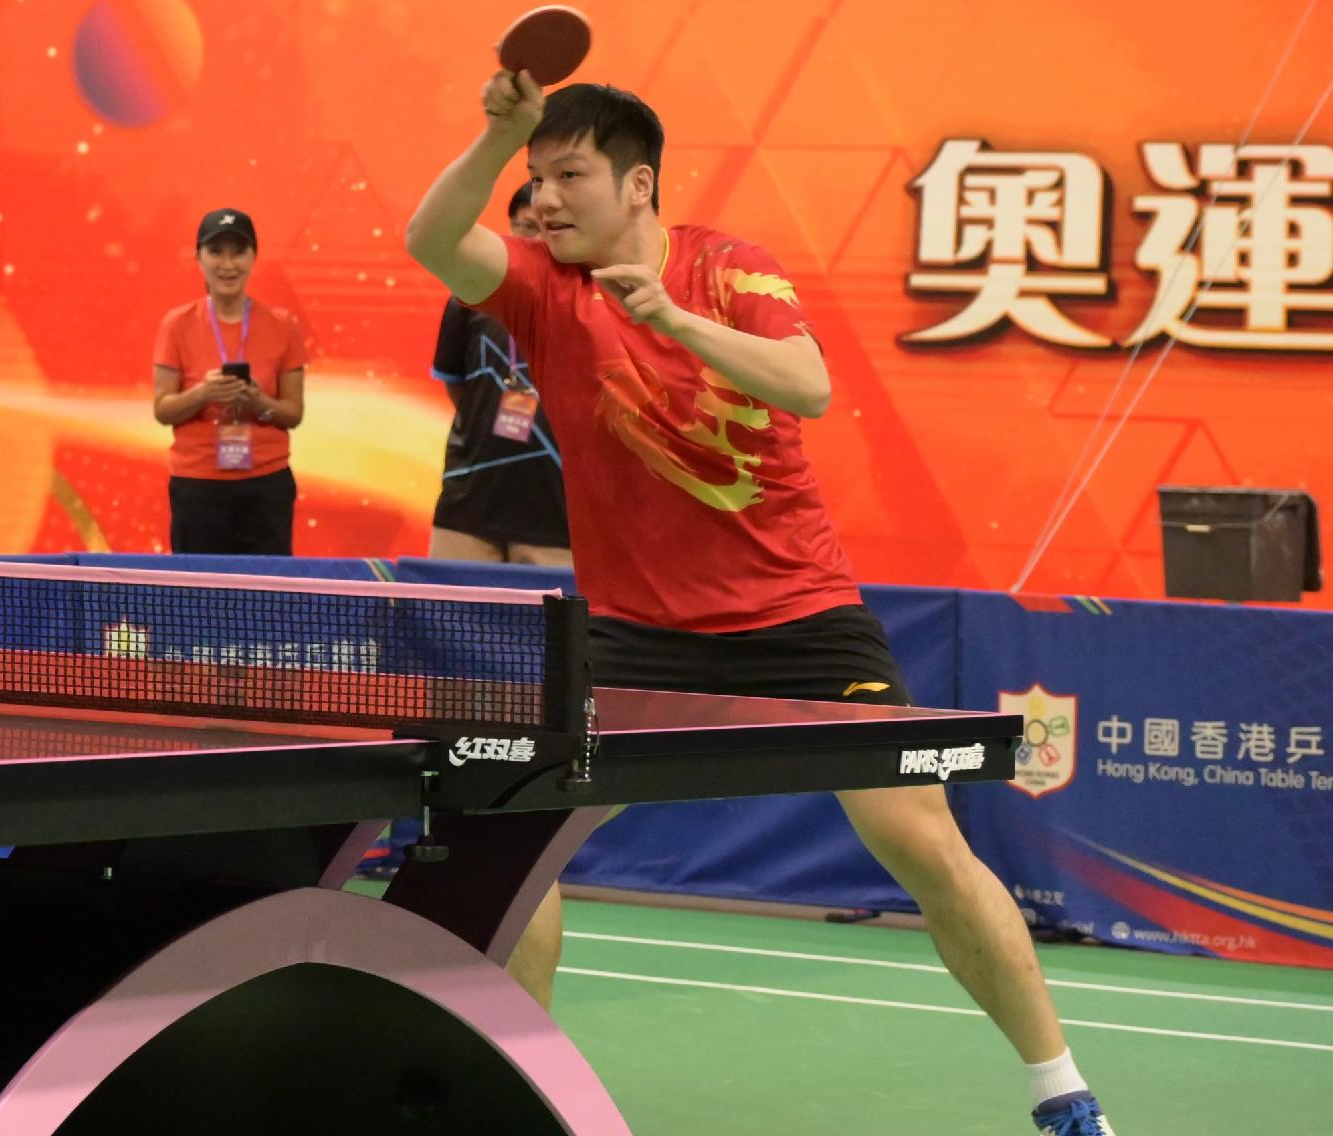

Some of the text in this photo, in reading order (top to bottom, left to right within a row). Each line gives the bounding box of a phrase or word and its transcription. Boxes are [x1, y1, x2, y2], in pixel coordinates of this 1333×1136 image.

[1096, 714, 1326, 764] 中國香港乒
[899, 749, 939, 774] PARIS
[1096, 758, 1145, 783] Hong
[1148, 761, 1199, 786] Kong,
[1203, 763, 1255, 786] China
[1259, 767, 1305, 789] Table
